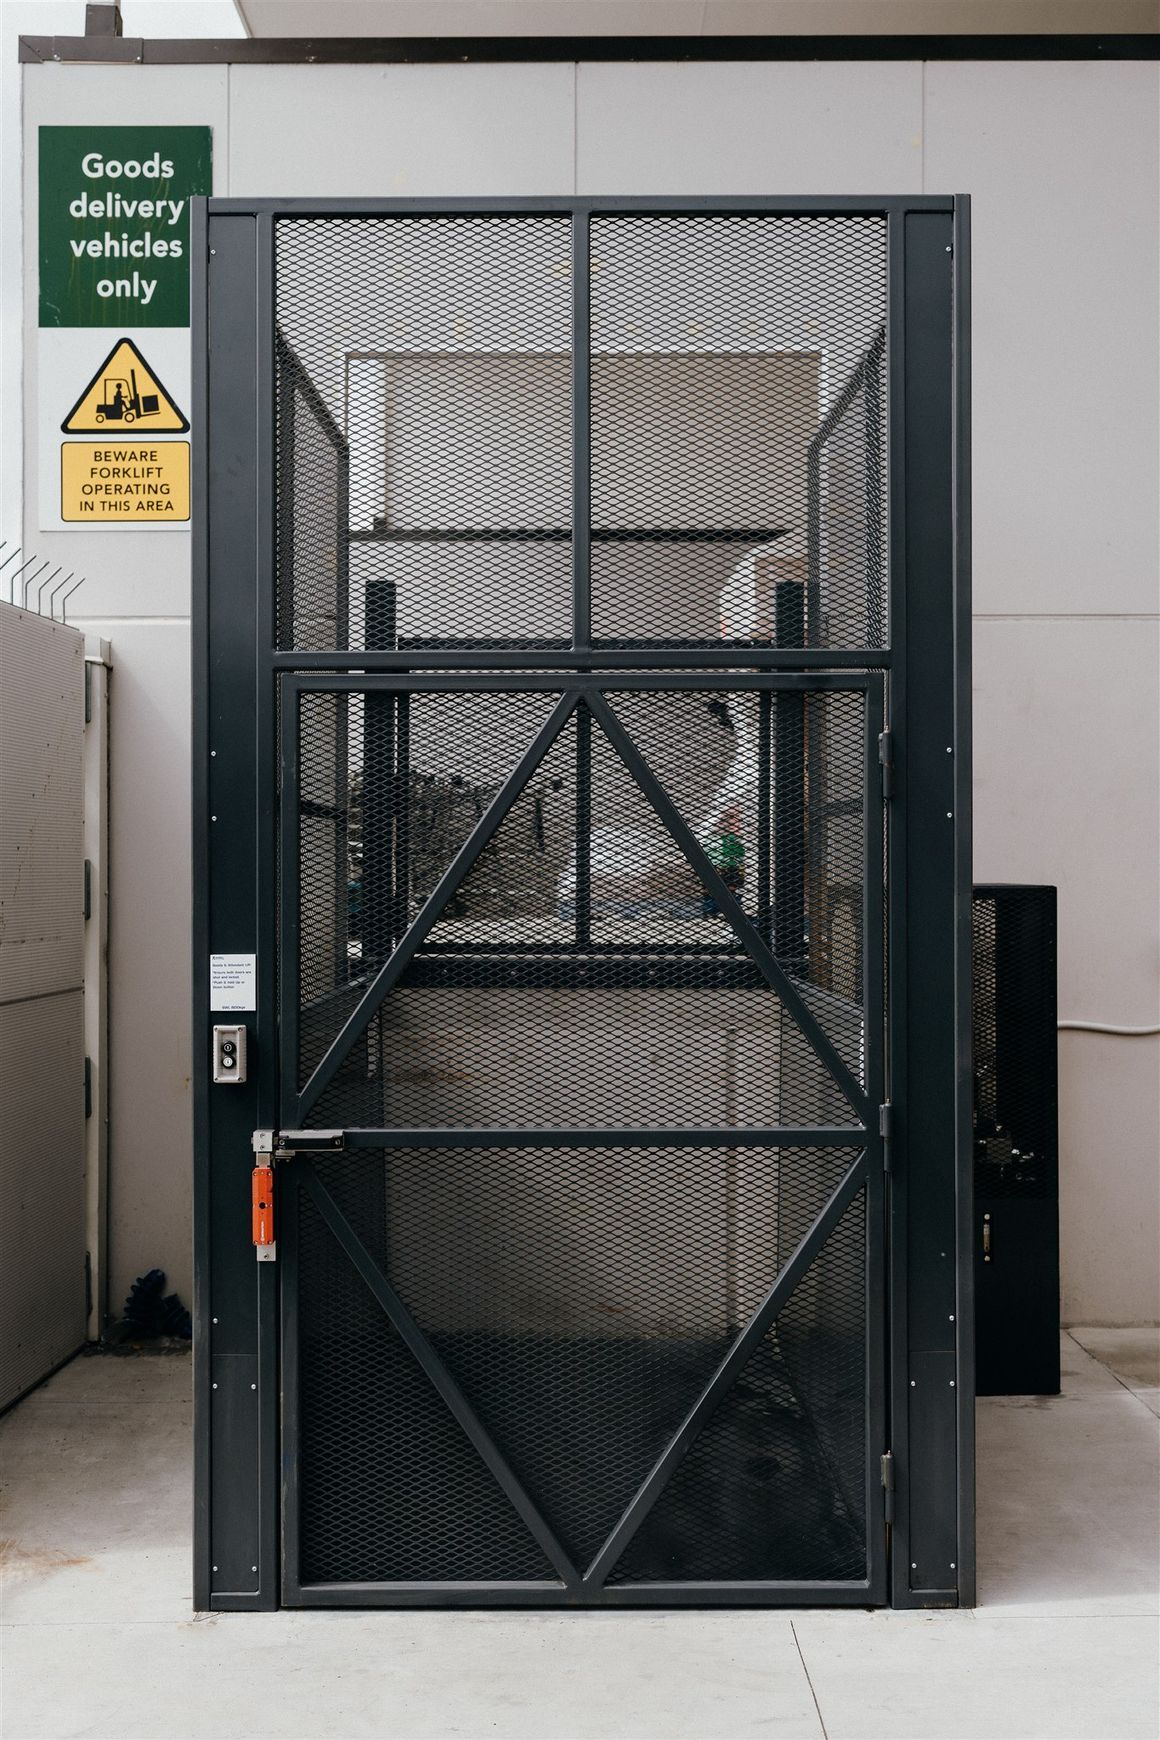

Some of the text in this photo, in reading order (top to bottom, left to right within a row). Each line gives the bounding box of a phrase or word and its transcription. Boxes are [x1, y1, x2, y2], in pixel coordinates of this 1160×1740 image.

[81, 152, 175, 179] Goods
[69, 192, 184, 225] delivery
[69, 231, 183, 258] vehicles
[96, 271, 158, 305] only
[94, 450, 158, 462] BEWARE
[90, 467, 163, 479] FORKLIFT
[81, 483, 170, 495] OPERATING
[79, 500, 174, 511] IN THIS AREA
